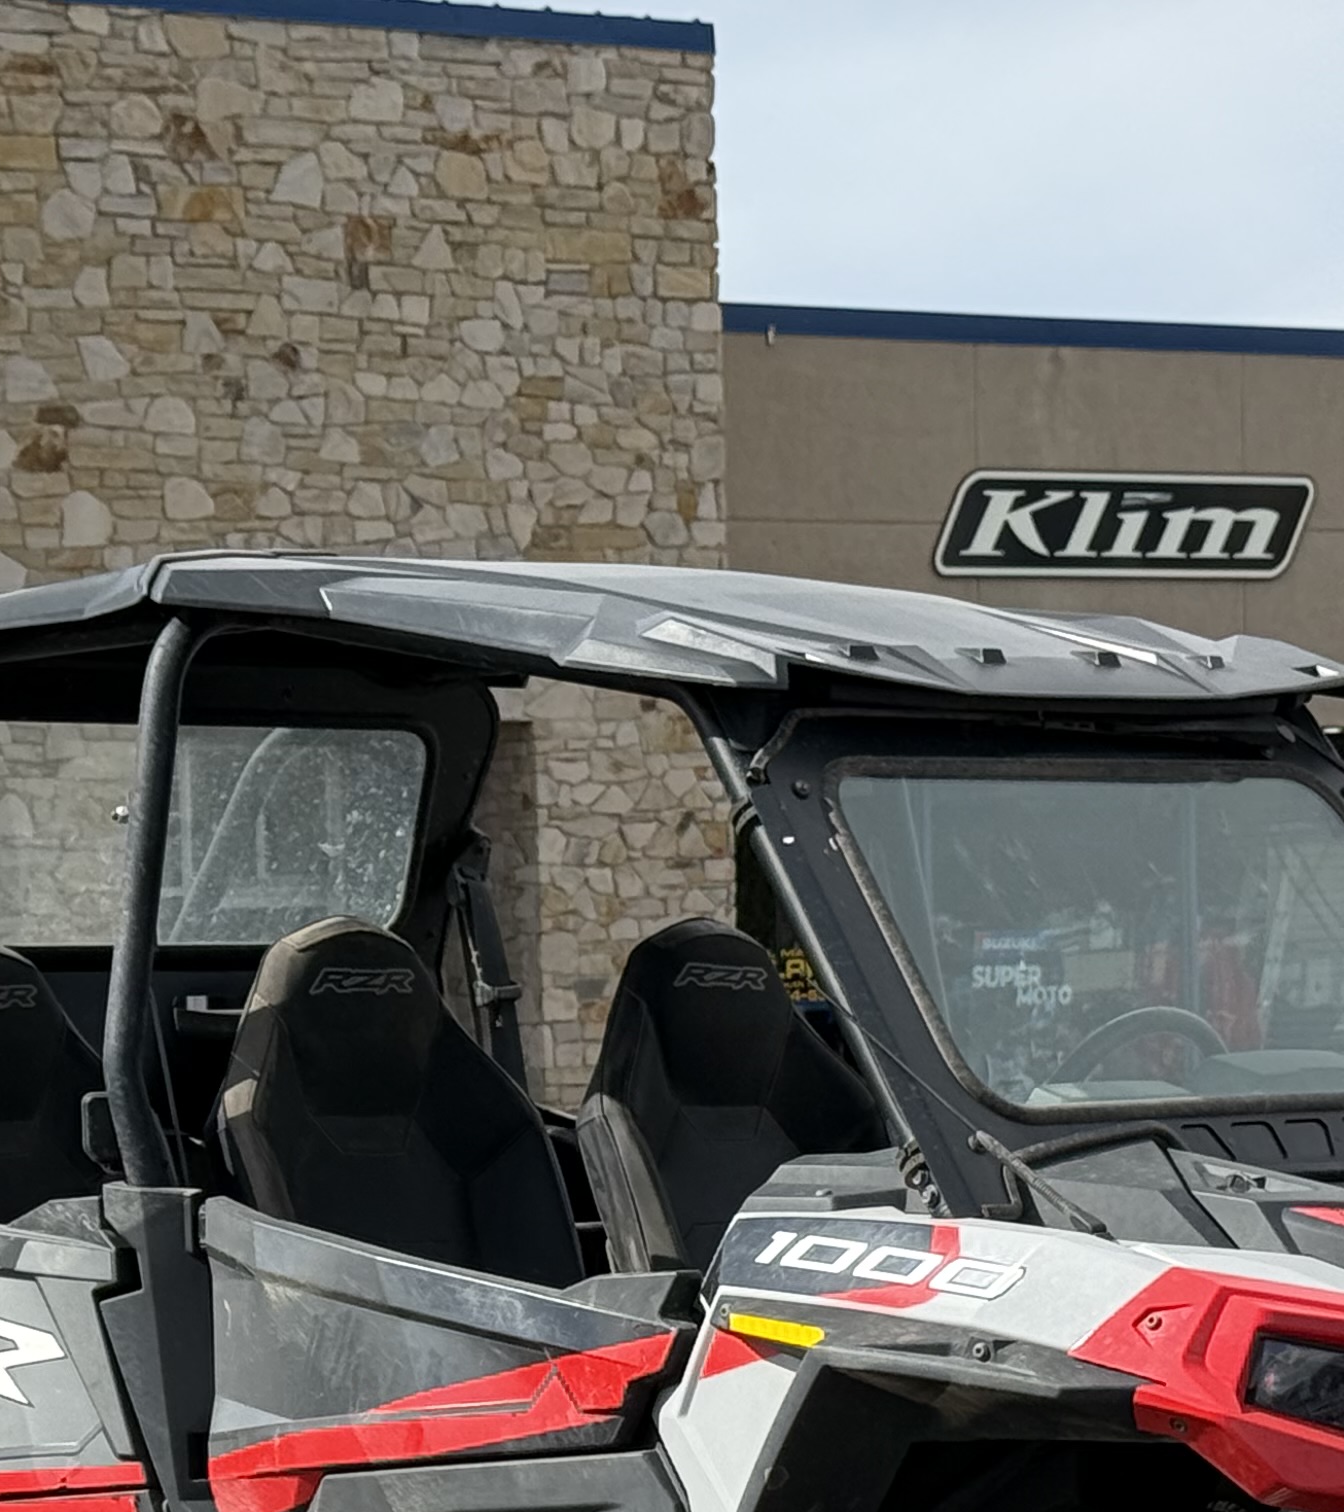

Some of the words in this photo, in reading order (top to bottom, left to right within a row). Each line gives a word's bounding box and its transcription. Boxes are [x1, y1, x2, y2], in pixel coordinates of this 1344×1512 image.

[308, 967, 415, 996] RZR
[673, 961, 768, 990] RZR
[971, 964, 1042, 989] SUPER
[1016, 984, 1073, 1007] MOTO
[754, 1230, 1027, 1301] 1000
